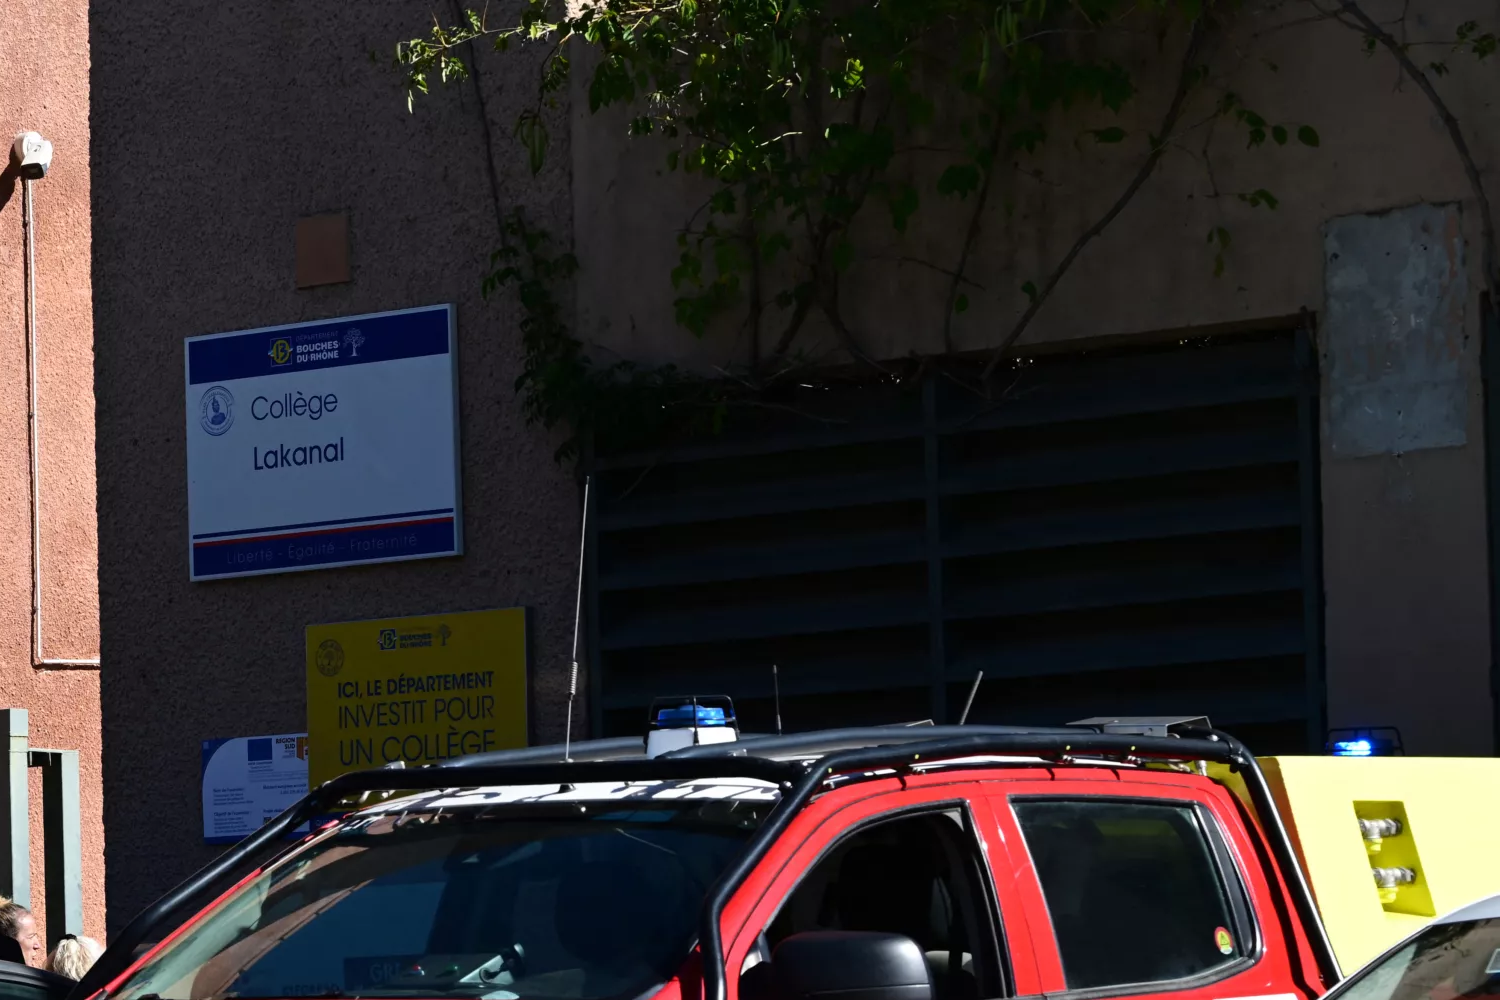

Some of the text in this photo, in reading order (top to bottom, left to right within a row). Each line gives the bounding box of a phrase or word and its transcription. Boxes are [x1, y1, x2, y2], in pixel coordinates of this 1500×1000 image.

[251, 391, 339, 422] Collège
[253, 437, 345, 471] Lakanal
[227, 548, 274, 565] Liberté
[288, 540, 335, 561] Égalité
[350, 533, 418, 553] Fraternité
[337, 670, 494, 700] ICI, LE DÉPARTEMENT
[339, 695, 495, 729] INVESTIT POUR
[339, 725, 496, 767] UN COLLÈGE
